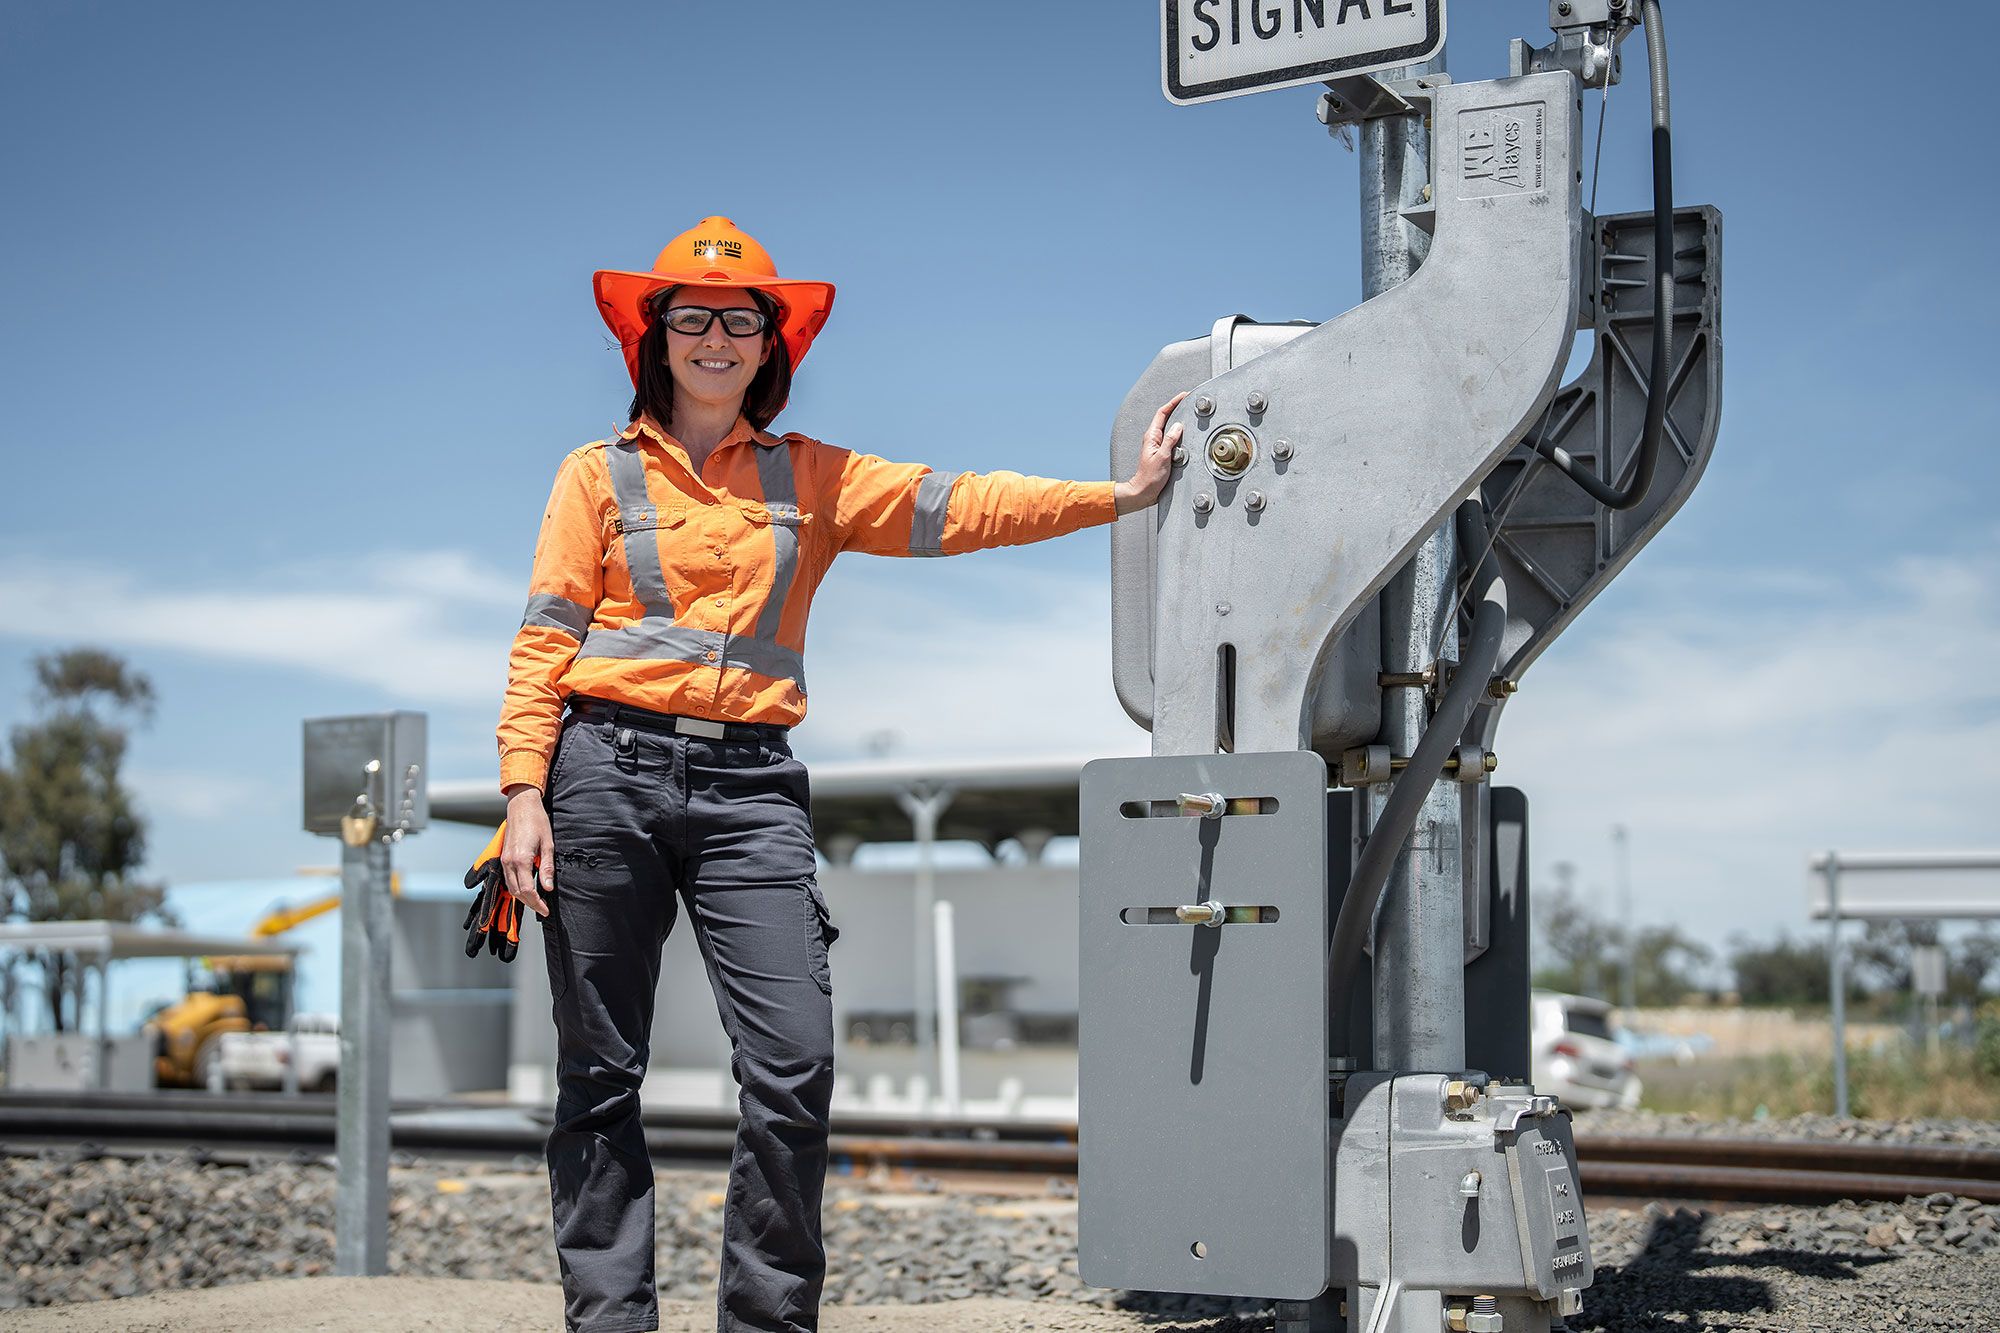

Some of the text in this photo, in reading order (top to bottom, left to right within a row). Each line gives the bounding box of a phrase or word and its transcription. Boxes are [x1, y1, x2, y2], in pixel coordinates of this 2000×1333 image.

[1191, 0, 1413, 52] SIGNA
[694, 240, 742, 250] INLAND
[694, 247, 722, 256] RAL
